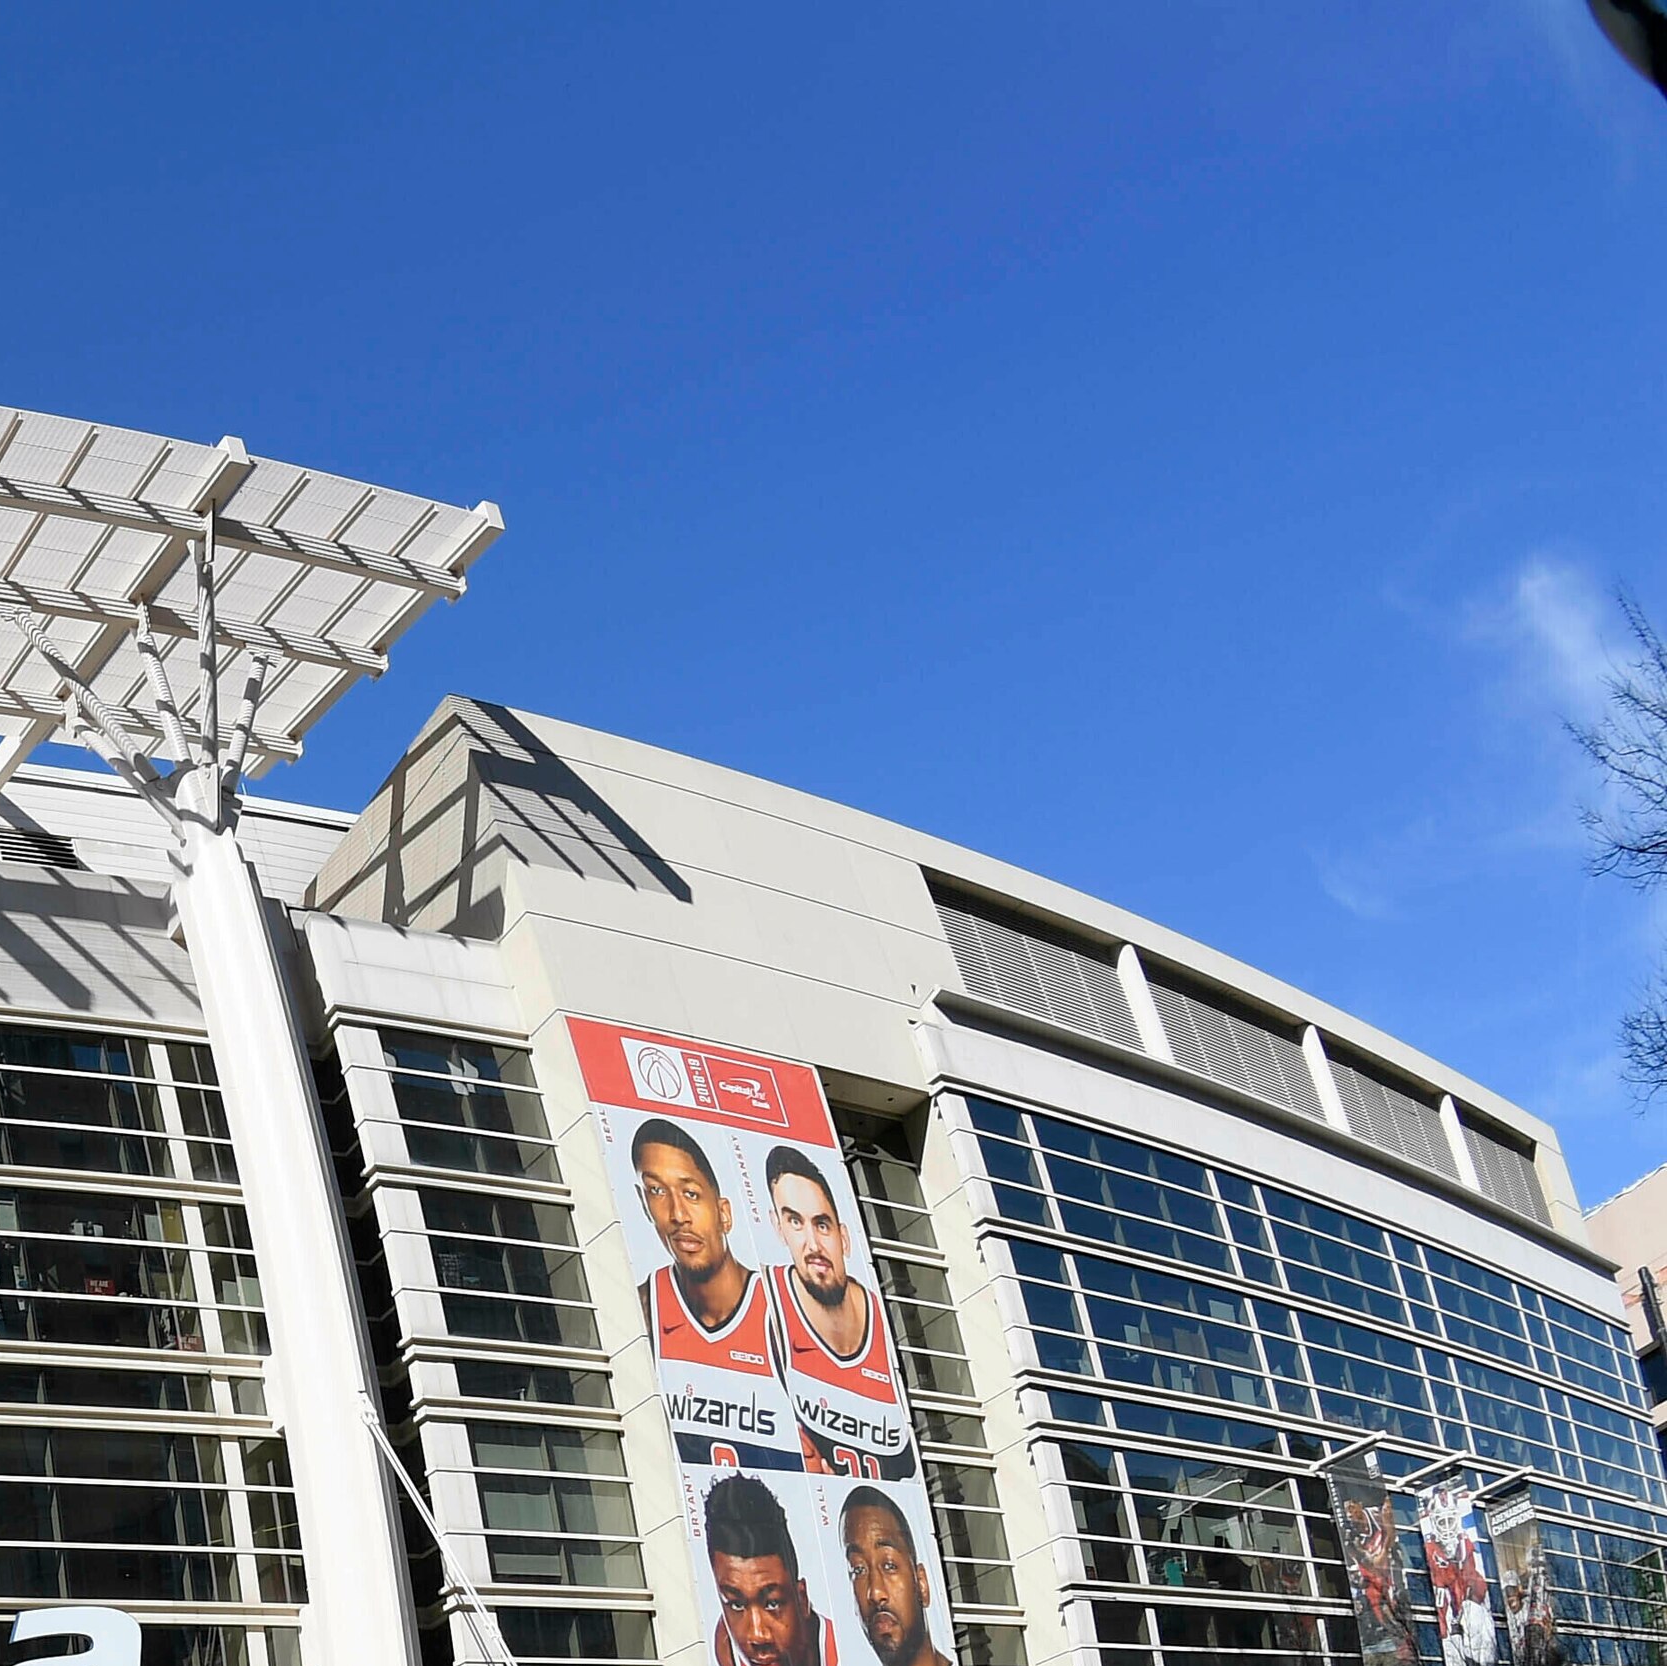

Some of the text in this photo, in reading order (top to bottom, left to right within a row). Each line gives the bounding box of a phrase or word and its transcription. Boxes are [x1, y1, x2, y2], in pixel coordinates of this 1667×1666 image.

[688, 1058, 712, 1104] 2018-19
[666, 1384, 777, 1436] wizards
[796, 1396, 902, 1447] wizards
[682, 1473, 702, 1537] BRYANT
[816, 1484, 830, 1526] WALL
